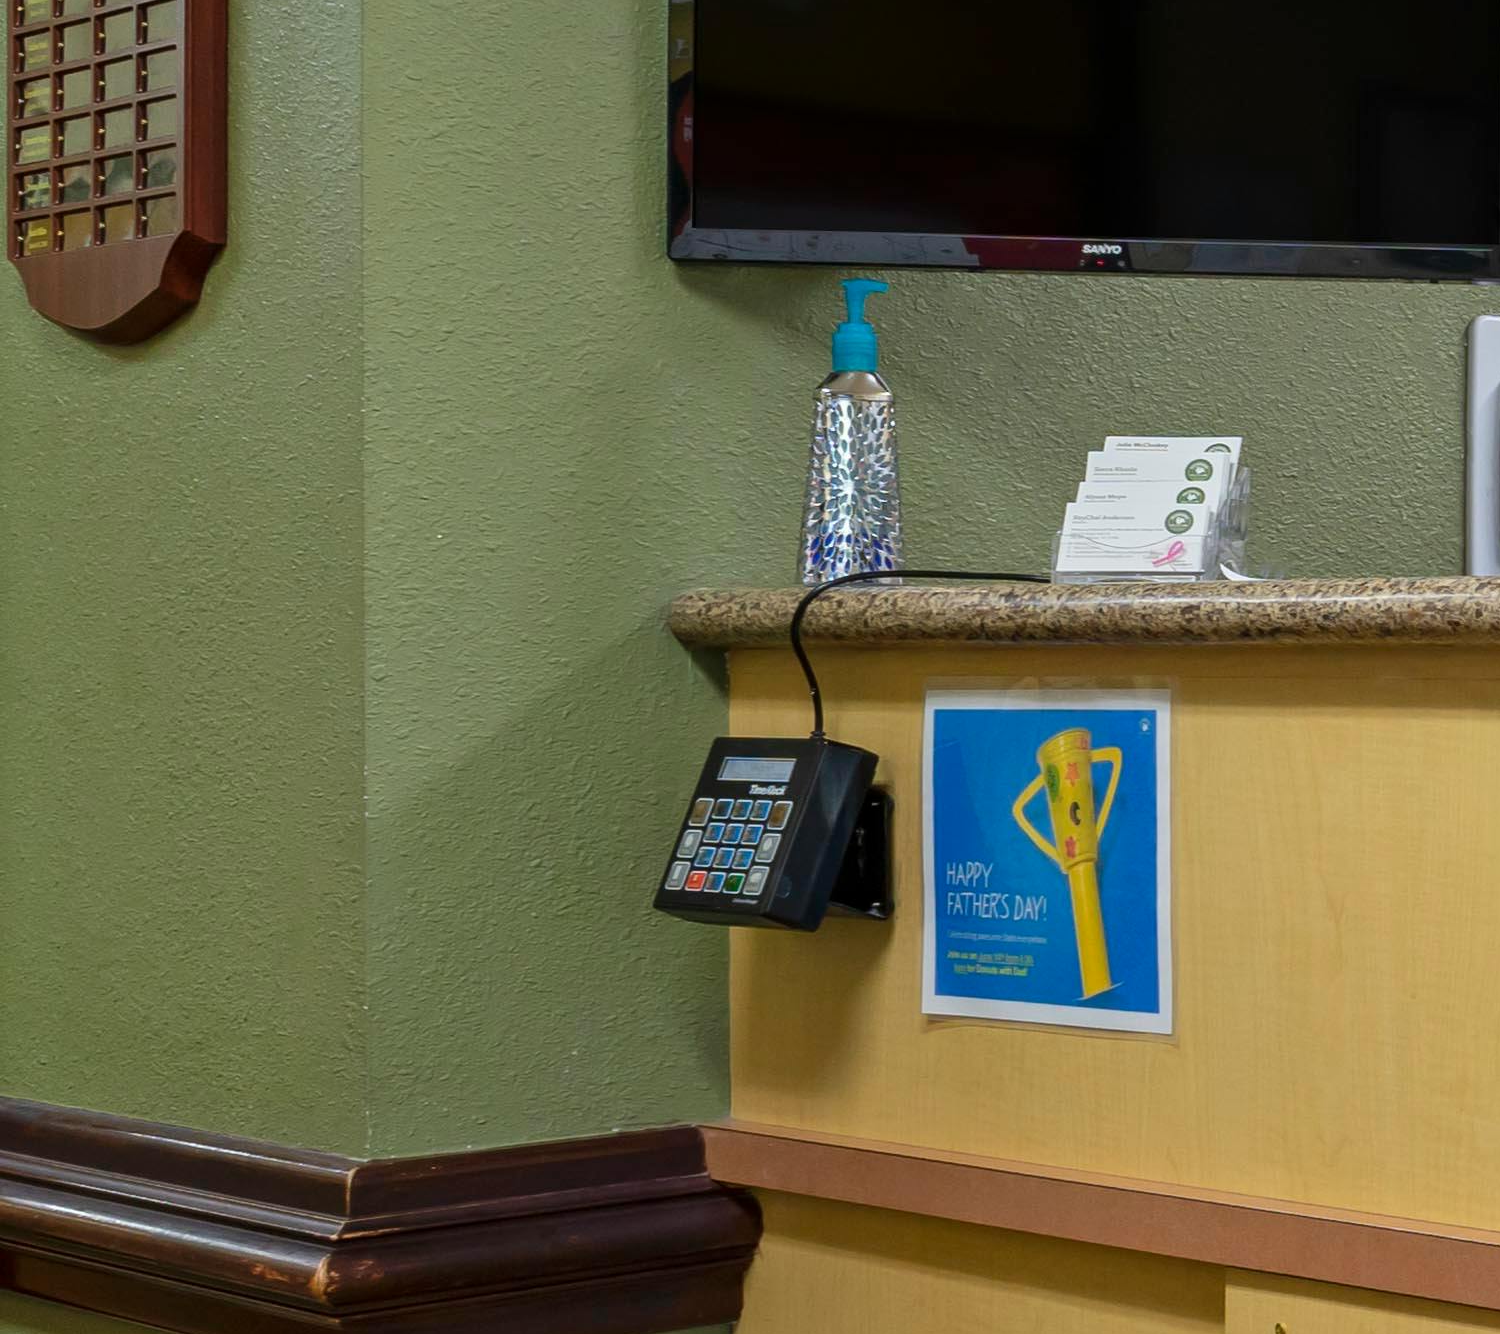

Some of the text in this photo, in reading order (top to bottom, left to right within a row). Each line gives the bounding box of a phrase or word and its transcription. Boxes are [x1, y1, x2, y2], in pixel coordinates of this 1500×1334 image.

[1081, 243, 1122, 255] SANYO
[946, 861, 994, 888] HAPPY
[1013, 895, 1047, 921] DAY!
